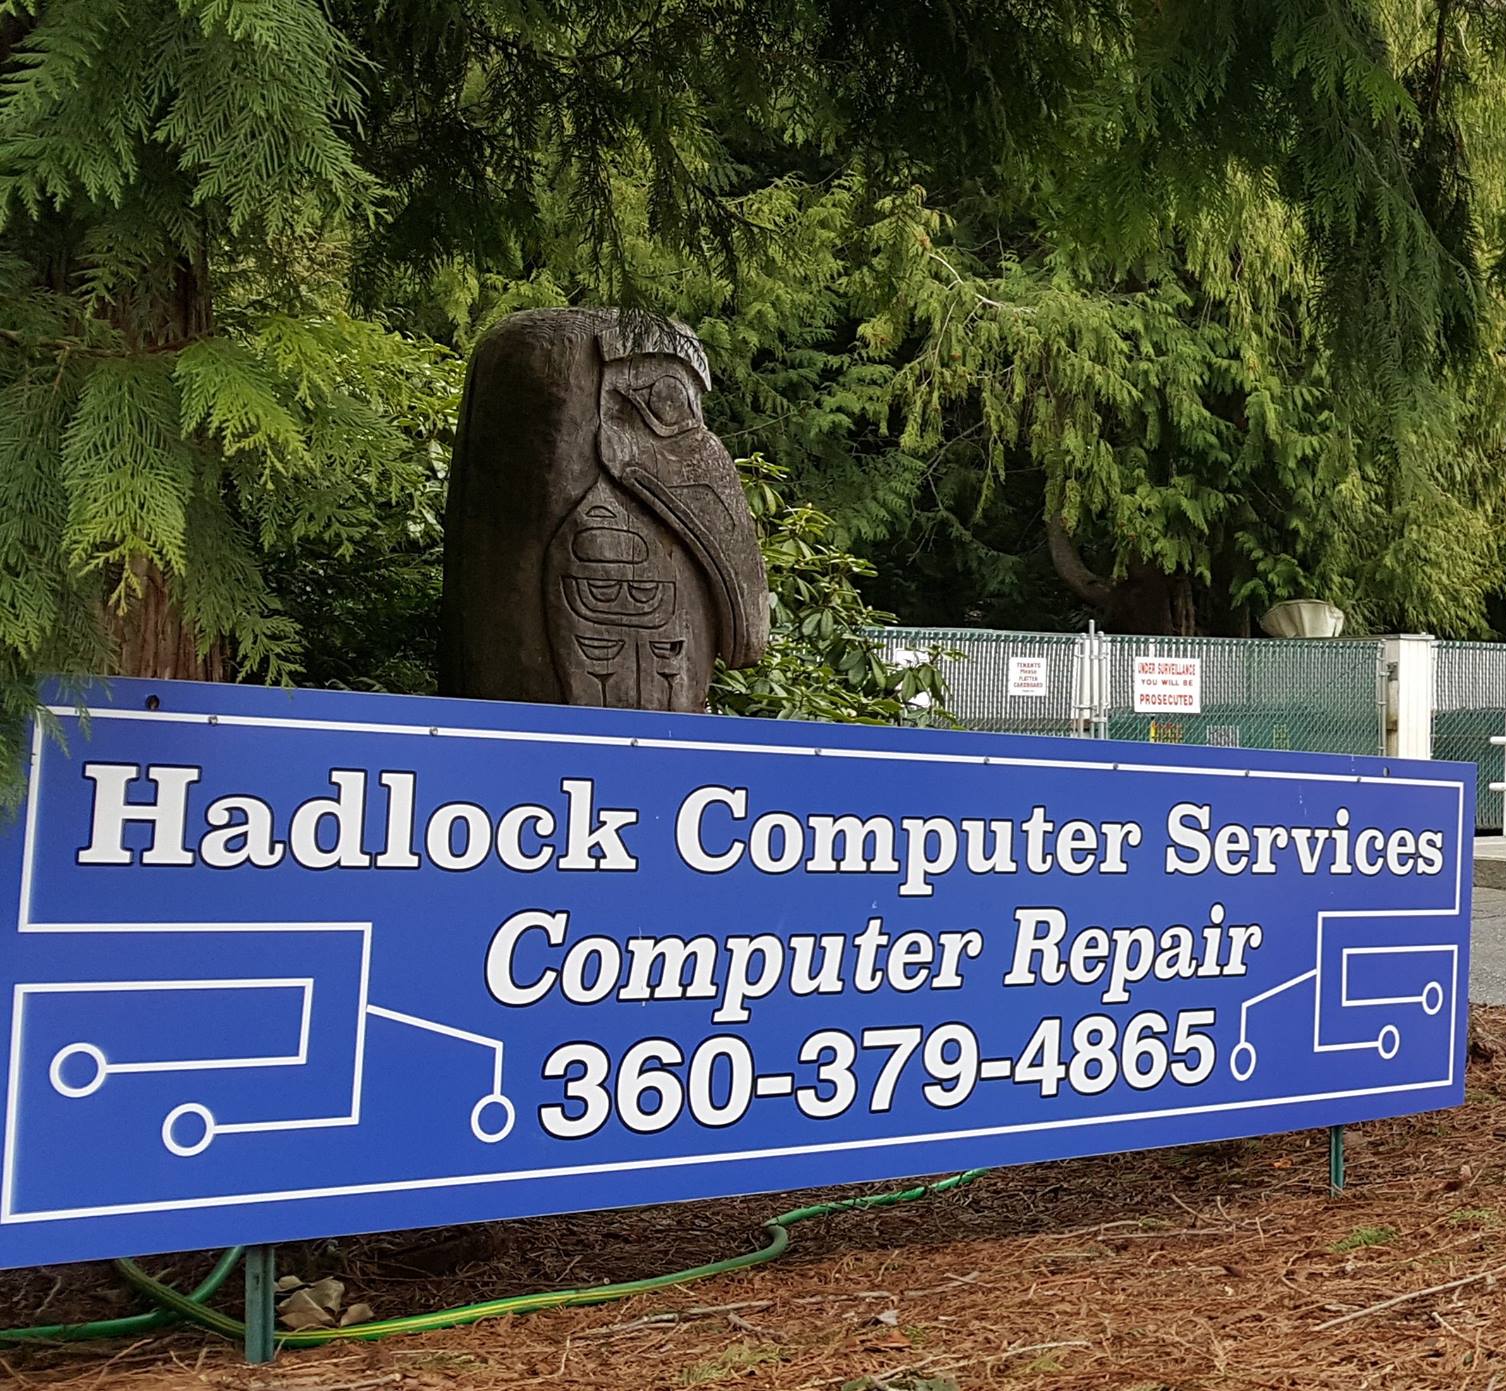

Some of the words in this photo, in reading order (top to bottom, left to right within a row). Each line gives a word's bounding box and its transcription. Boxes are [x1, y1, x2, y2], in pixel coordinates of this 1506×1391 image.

[1138, 662, 1155, 674] UNDER
[1157, 663, 1196, 676] SURVEILLANCE
[1139, 693, 1194, 706] PROSECUTED
[1141, 678, 1158, 686] YOU
[1161, 679, 1179, 687] WILL
[1182, 679, 1193, 687] BE
[76, 762, 639, 872] Hadlock
[675, 786, 1142, 897] Computer
[1164, 802, 1446, 876] Services
[484, 910, 983, 1024] Computer
[1003, 903, 1264, 1004] Repair
[538, 1009, 1218, 1140] 360-379-4865
